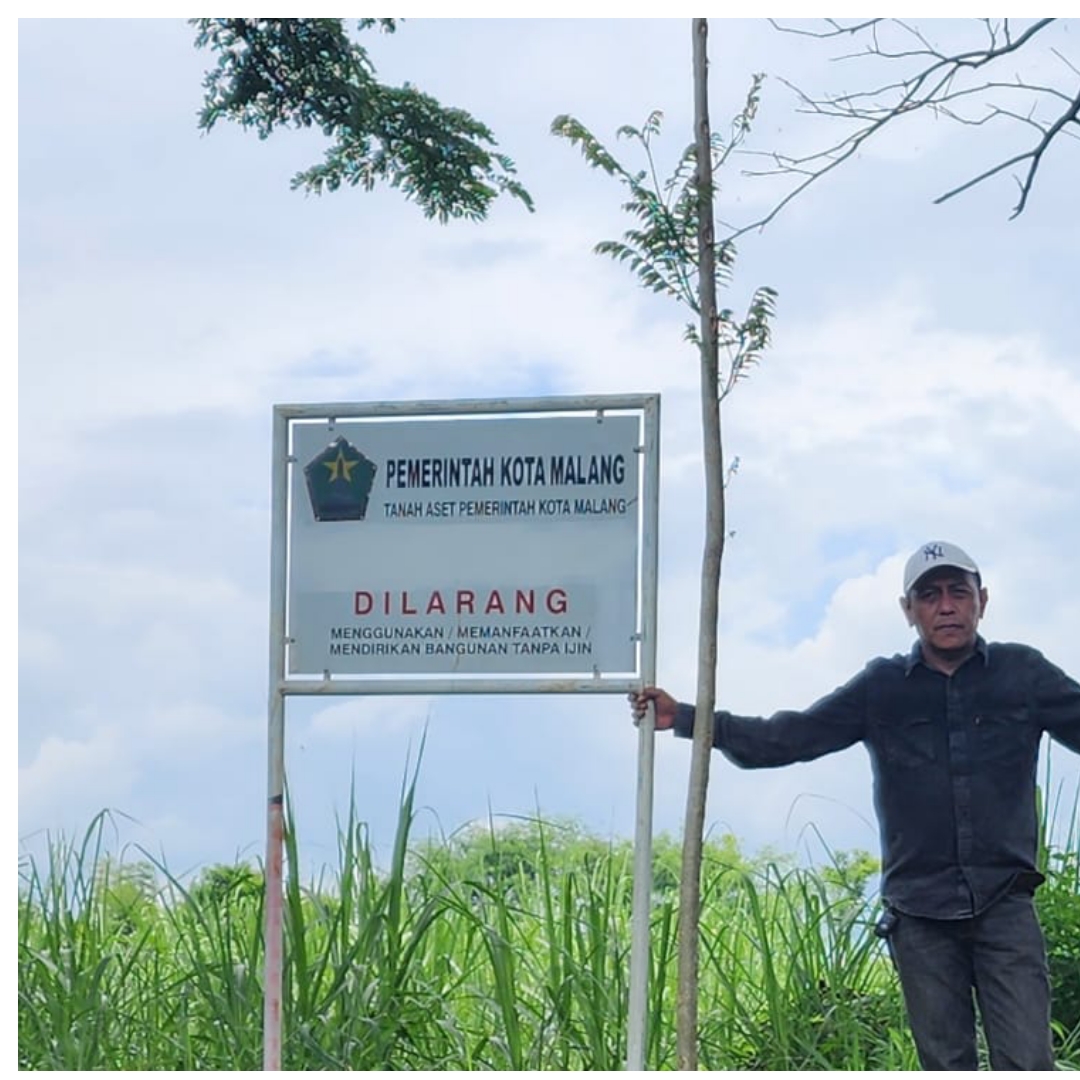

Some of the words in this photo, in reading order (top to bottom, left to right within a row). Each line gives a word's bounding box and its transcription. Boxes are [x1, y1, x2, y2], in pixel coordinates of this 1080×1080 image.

[386, 457, 495, 489] PEMERINTAH
[500, 455, 546, 487] KOTA
[550, 454, 625, 486] MALANG
[383, 502, 423, 518] TANAH
[425, 501, 456, 517] ASET
[459, 500, 535, 517] PEMERINTAH
[538, 499, 571, 516] KOTA
[573, 498, 627, 516] MALANG
[354, 589, 569, 615] DILARANG
[330, 627, 444, 640] MENGGUNAKAN
[457, 625, 582, 639] MEMANFAATKAN
[329, 643, 421, 656] MENDIRIKAN
[425, 642, 508, 655] BANGUNAN
[512, 642, 562, 654] TANPA
[564, 642, 593, 655] IJIN
